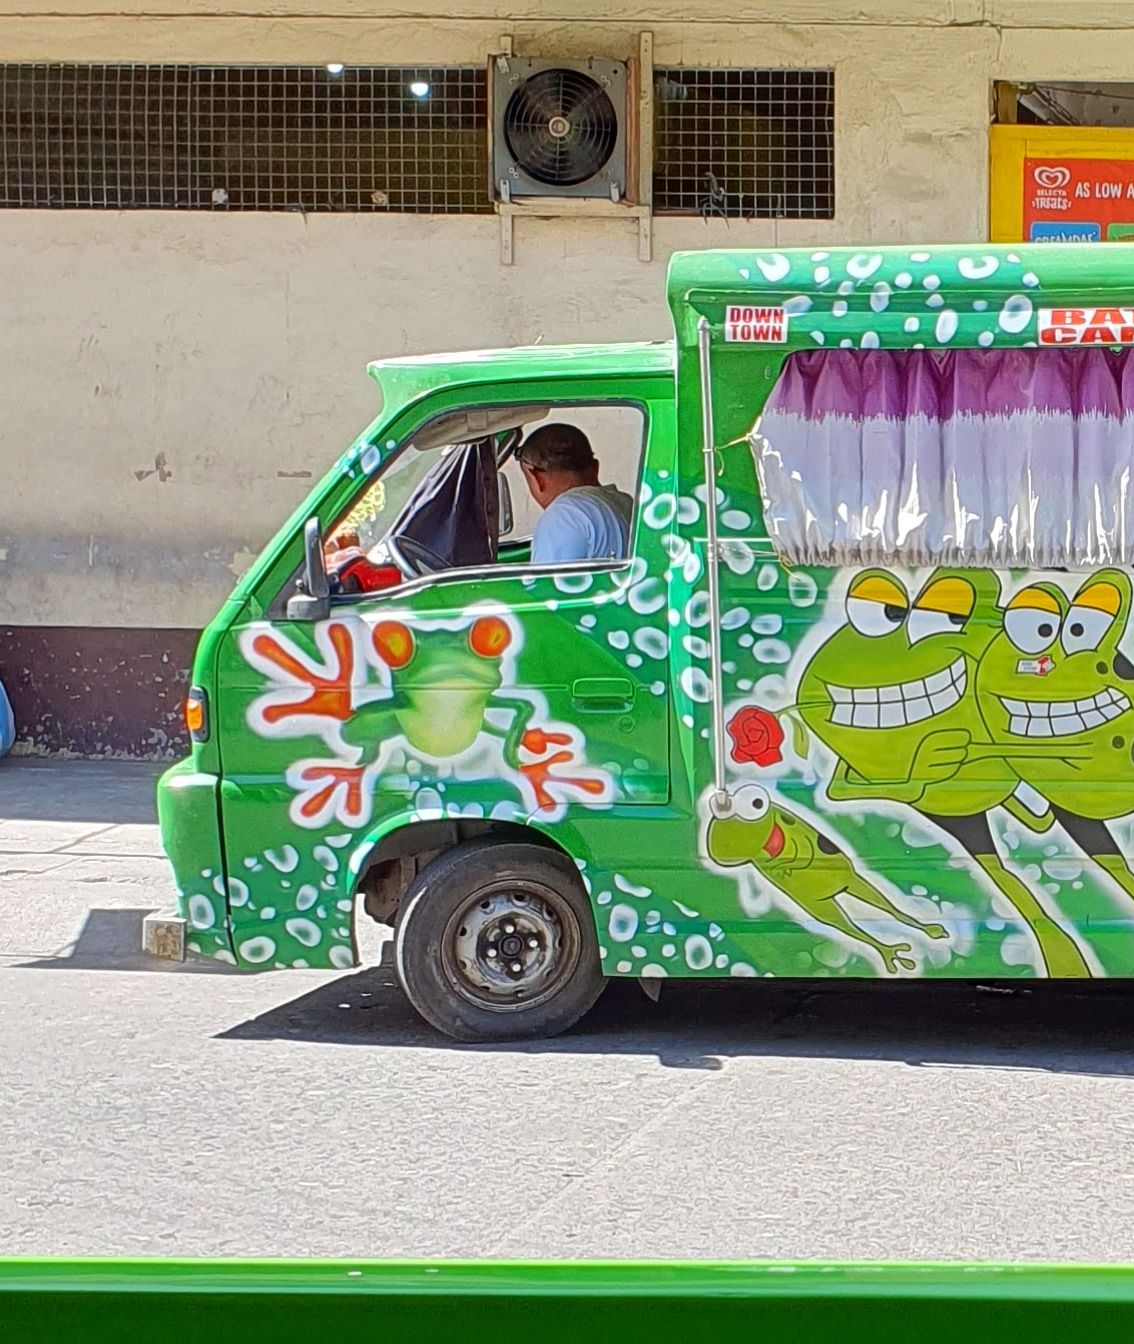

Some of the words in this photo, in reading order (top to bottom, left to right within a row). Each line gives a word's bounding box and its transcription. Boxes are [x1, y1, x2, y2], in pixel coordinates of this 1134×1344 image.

[1036, 189, 1067, 197] SELECTA
[1075, 182, 1091, 199] AS
[1095, 182, 1123, 199] LOW
[729, 307, 785, 324] DOWN
[729, 324, 783, 341] TOWN
